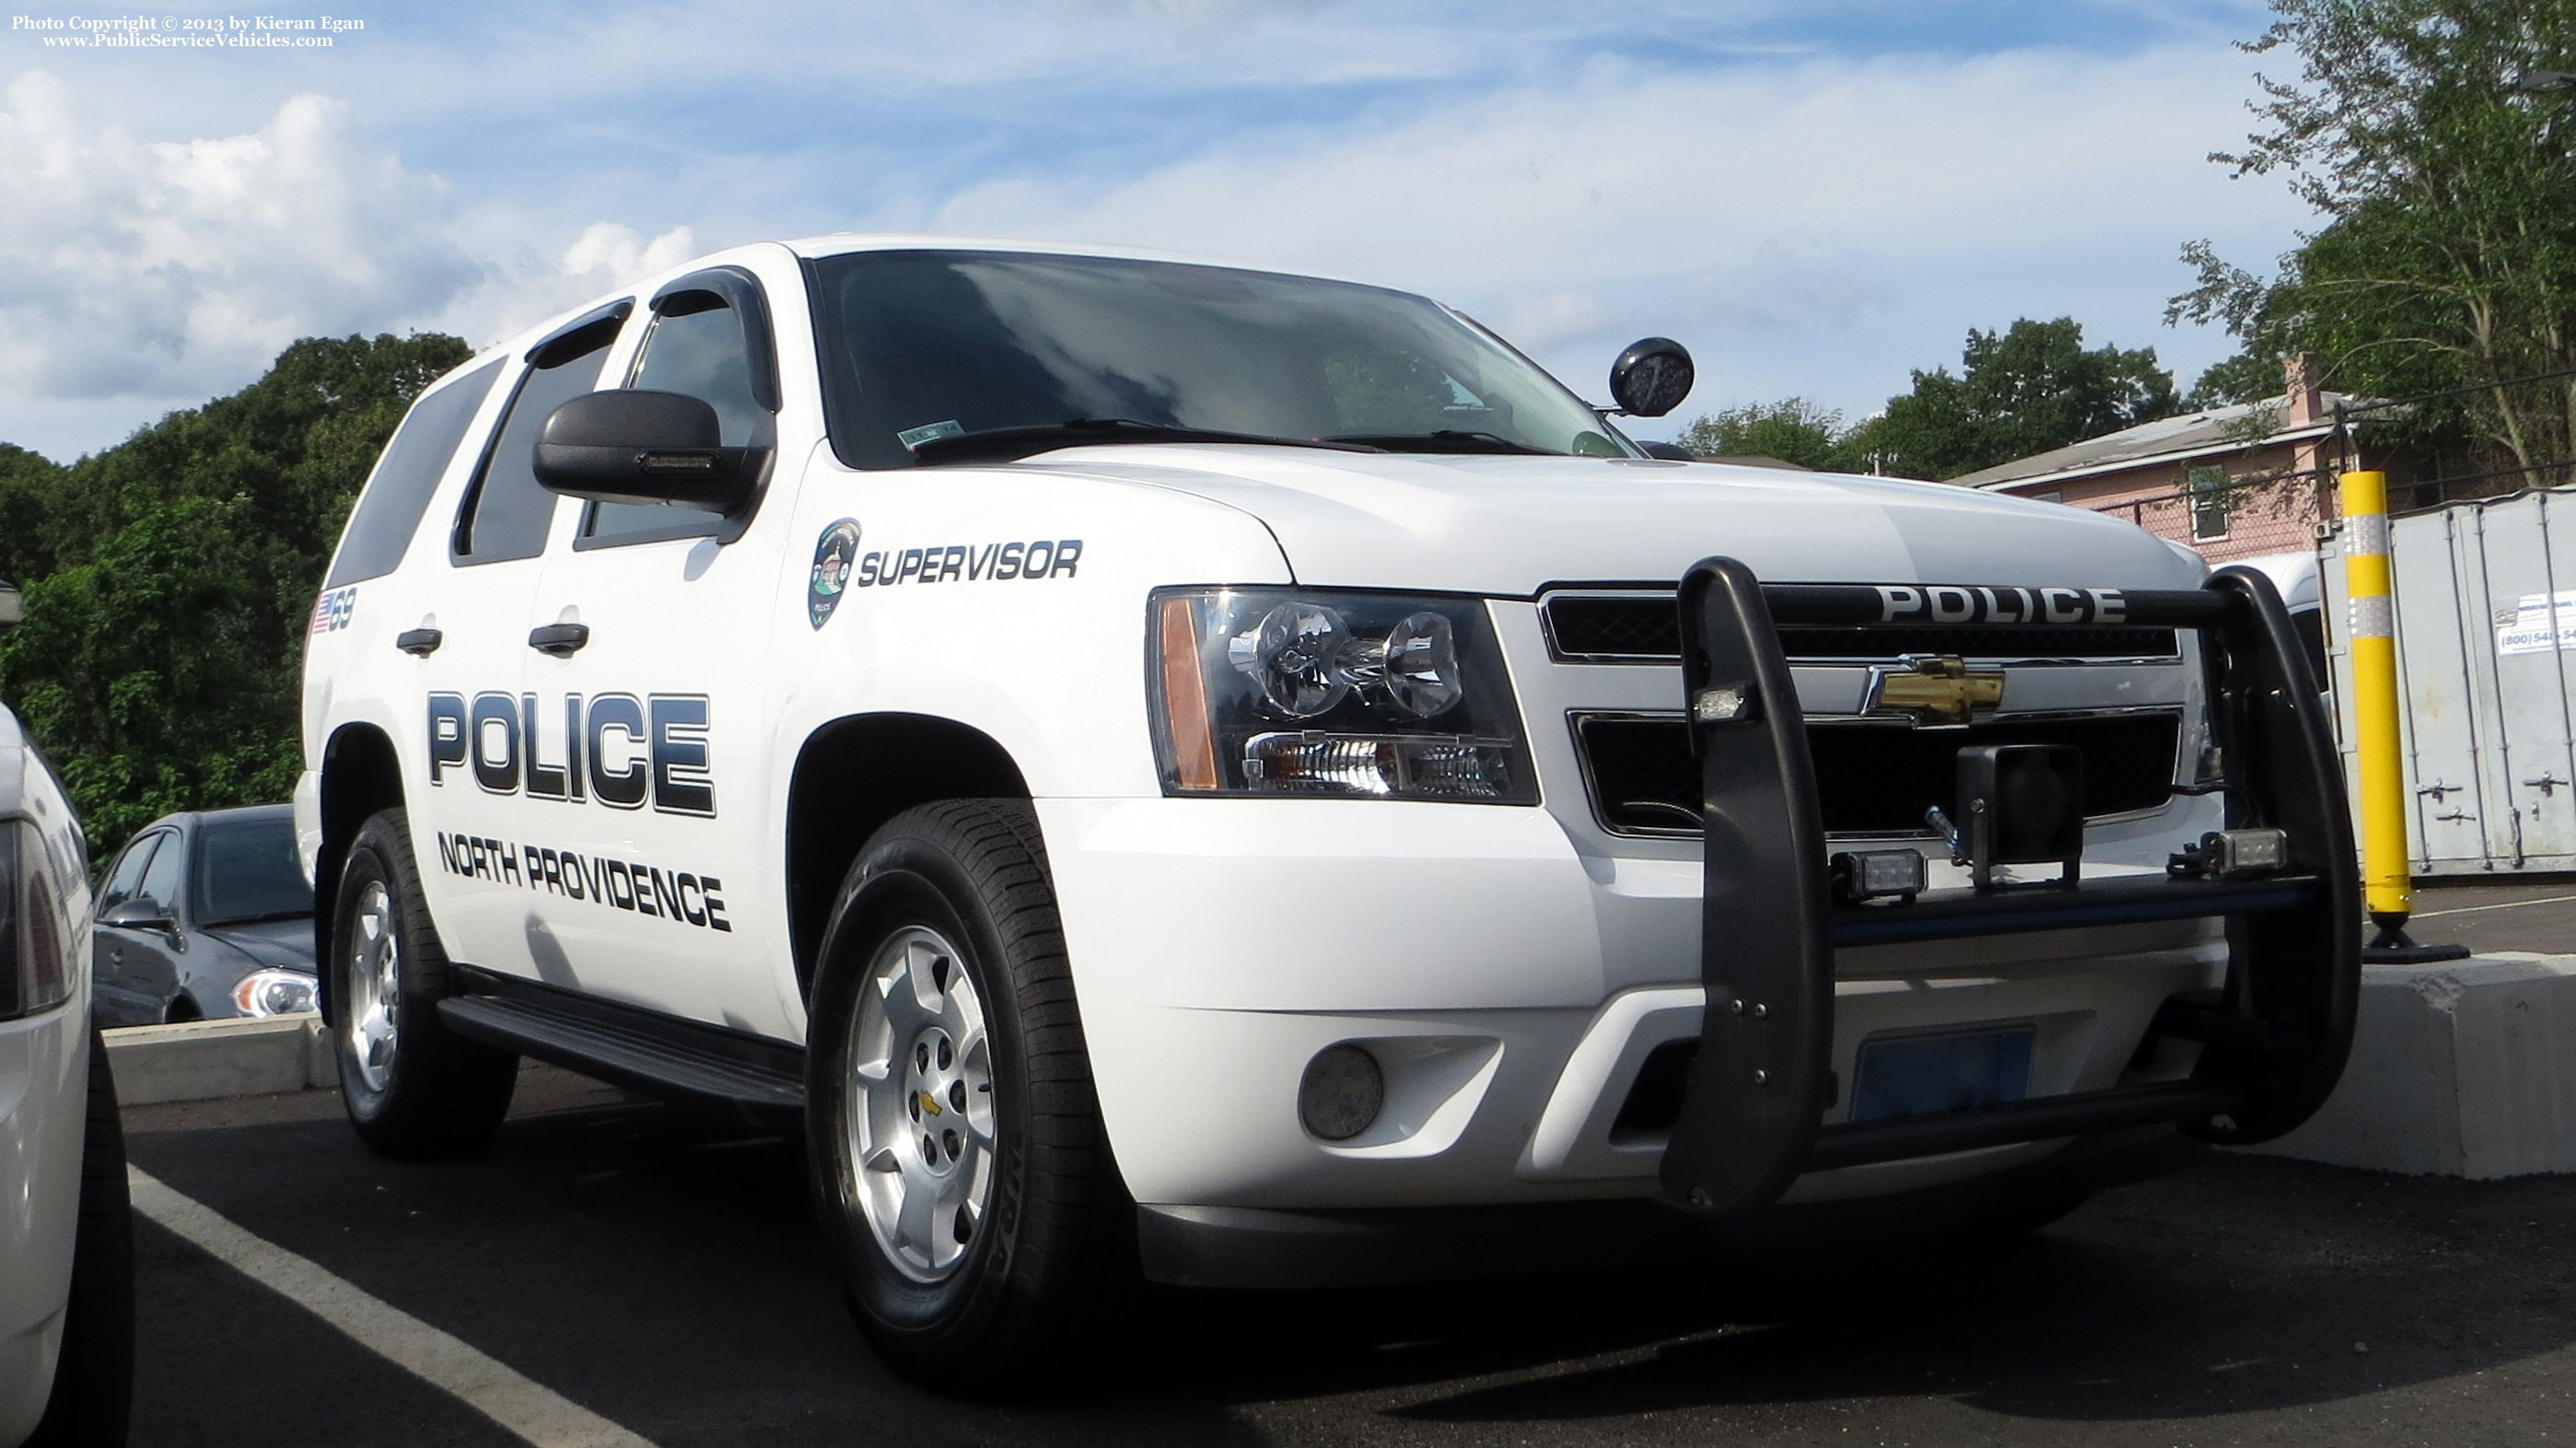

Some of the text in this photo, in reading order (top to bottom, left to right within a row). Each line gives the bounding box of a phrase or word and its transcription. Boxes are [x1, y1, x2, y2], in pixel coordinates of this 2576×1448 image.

[858, 540, 1083, 587] SUPERVISOR
[329, 587, 358, 632] 69
[1874, 585, 2127, 624] POLICE
[427, 691, 717, 819] POLICE
[437, 831, 733, 933] NORTH PROVIDENCE
